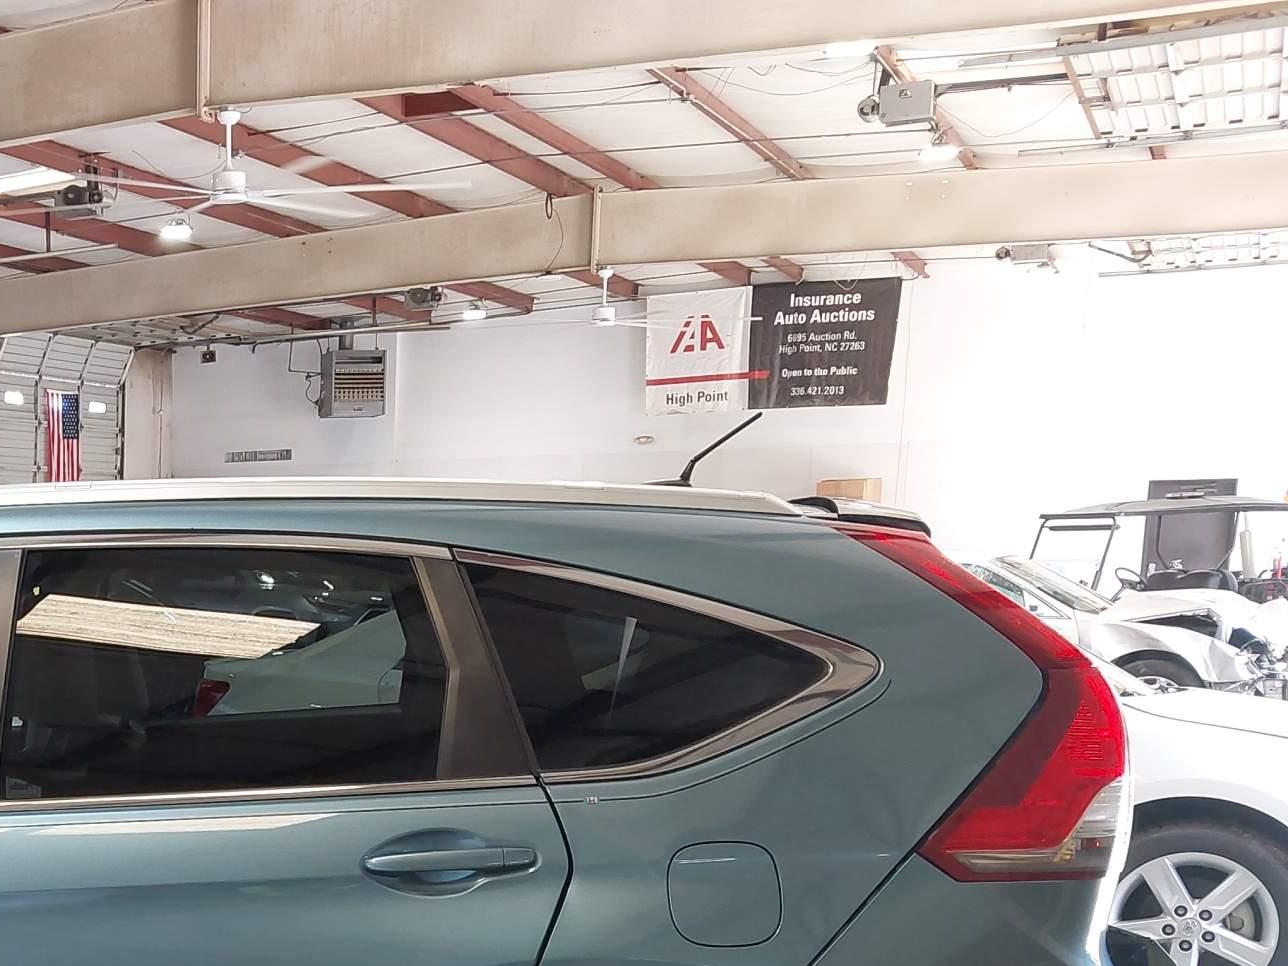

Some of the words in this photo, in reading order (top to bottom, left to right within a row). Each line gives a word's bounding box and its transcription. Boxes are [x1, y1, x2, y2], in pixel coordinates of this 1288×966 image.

[790, 292, 862, 308] Insurance
[774, 309, 807, 326] Auto
[810, 307, 875, 324] Auctions
[787, 333, 807, 343] 6695
[808, 332, 842, 342] Auction
[843, 330, 857, 340] Rd.
[778, 344, 797, 355] High
[824, 342, 838, 352] NC
[839, 341, 866, 351] 27263
[781, 368, 803, 379] Open
[804, 368, 813, 376] to
[814, 367, 828, 376] the
[829, 366, 858, 375] Public
[790, 385, 845, 396] 336.421.2013
[666, 392, 694, 407] High
[697, 390, 729, 403] Point
